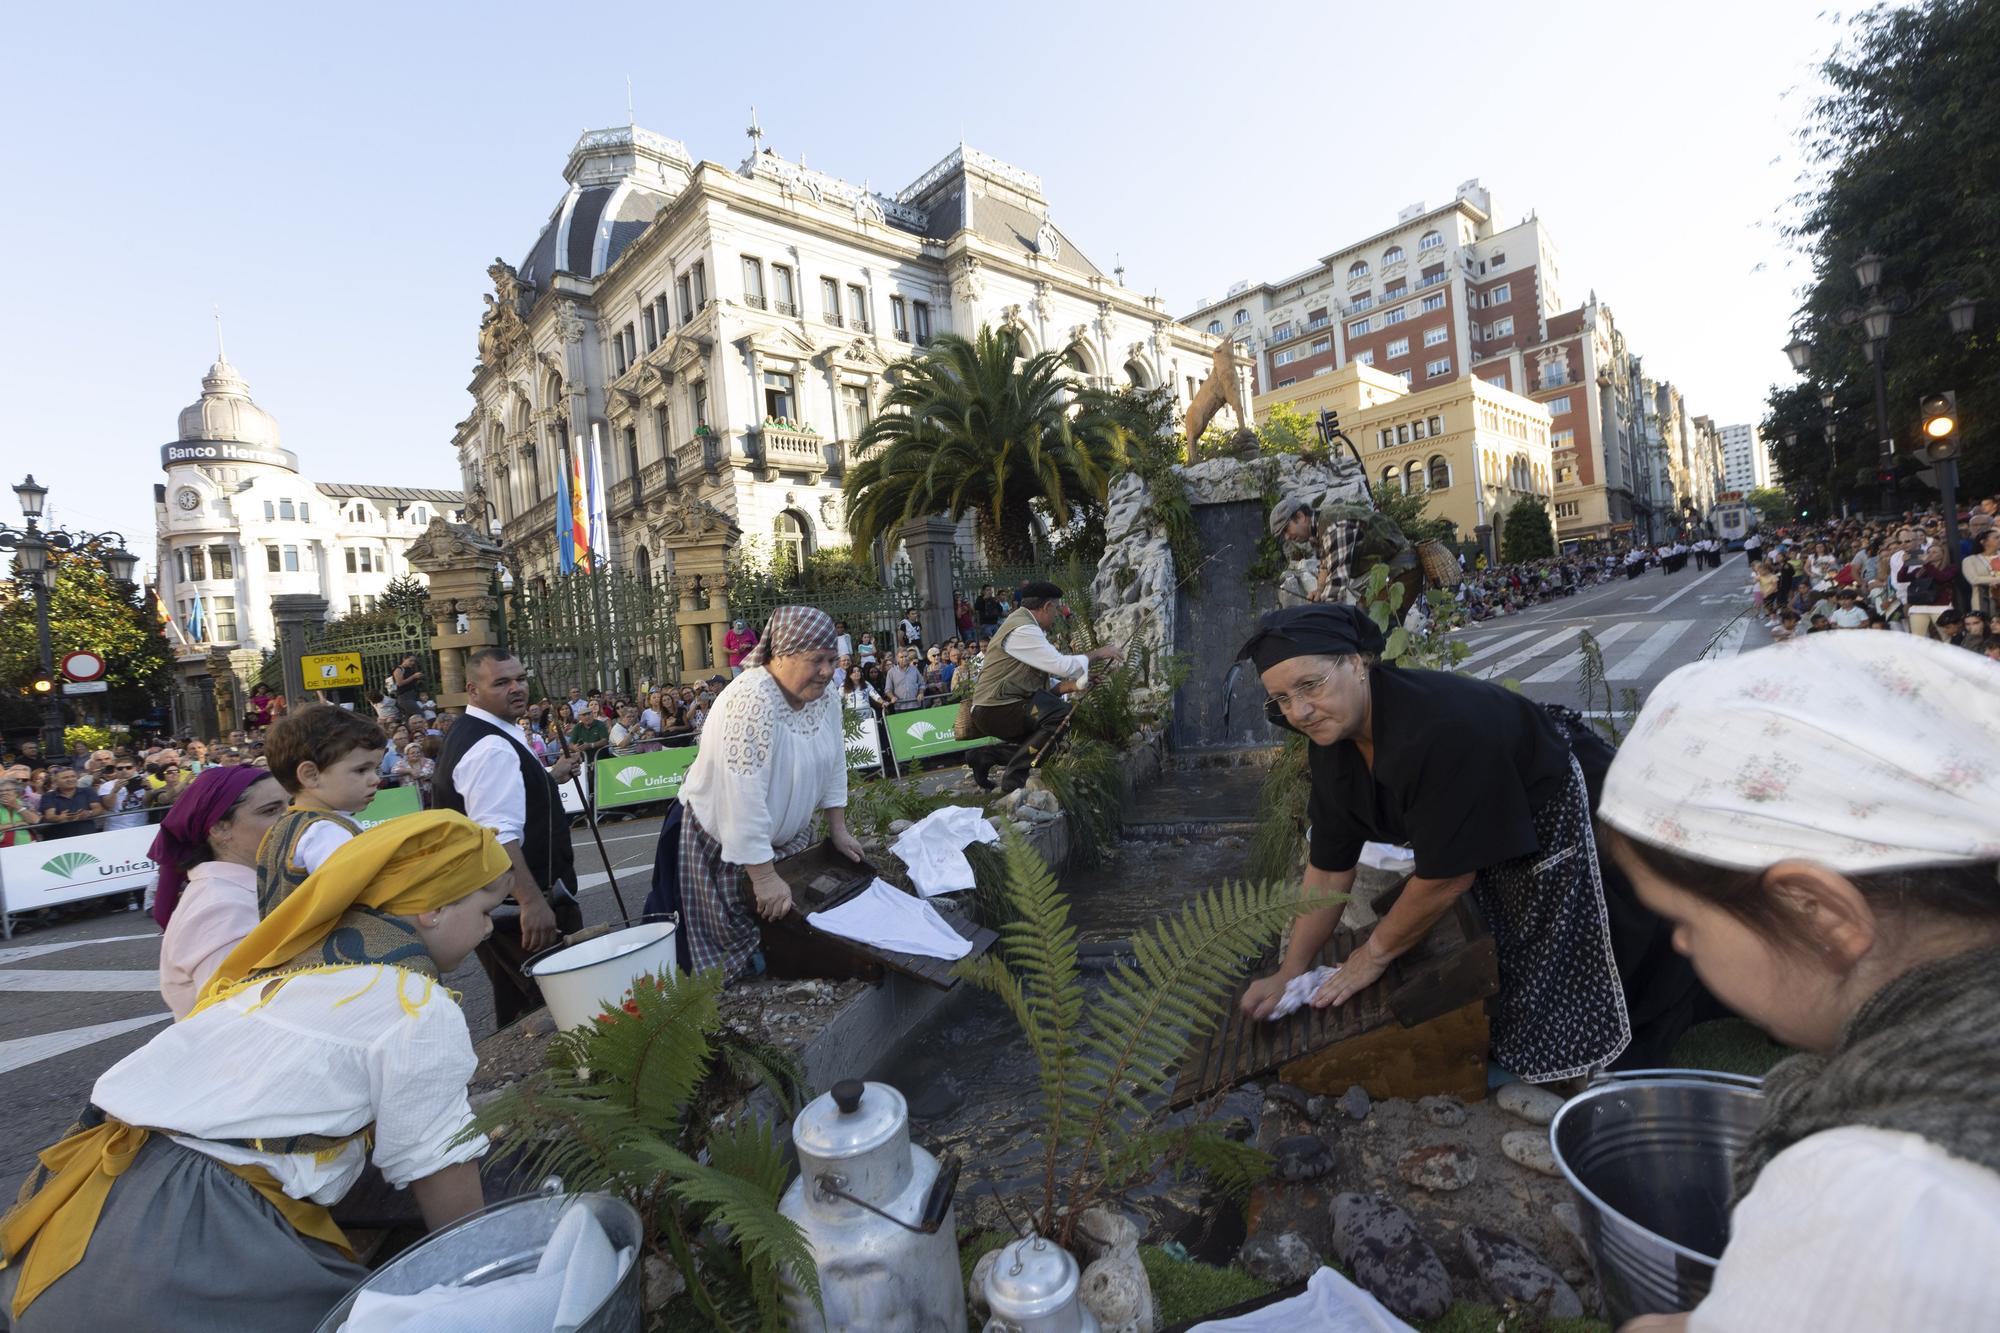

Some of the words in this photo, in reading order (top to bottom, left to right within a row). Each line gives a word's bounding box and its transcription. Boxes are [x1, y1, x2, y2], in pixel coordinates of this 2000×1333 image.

[168, 447, 216, 459] Banco
[313, 655, 350, 664] OFICINA
[307, 680, 320, 688] DE
[323, 677, 361, 686] TURISMO
[644, 772, 682, 787] Unicaja
[99, 860, 160, 876] Unicaj
